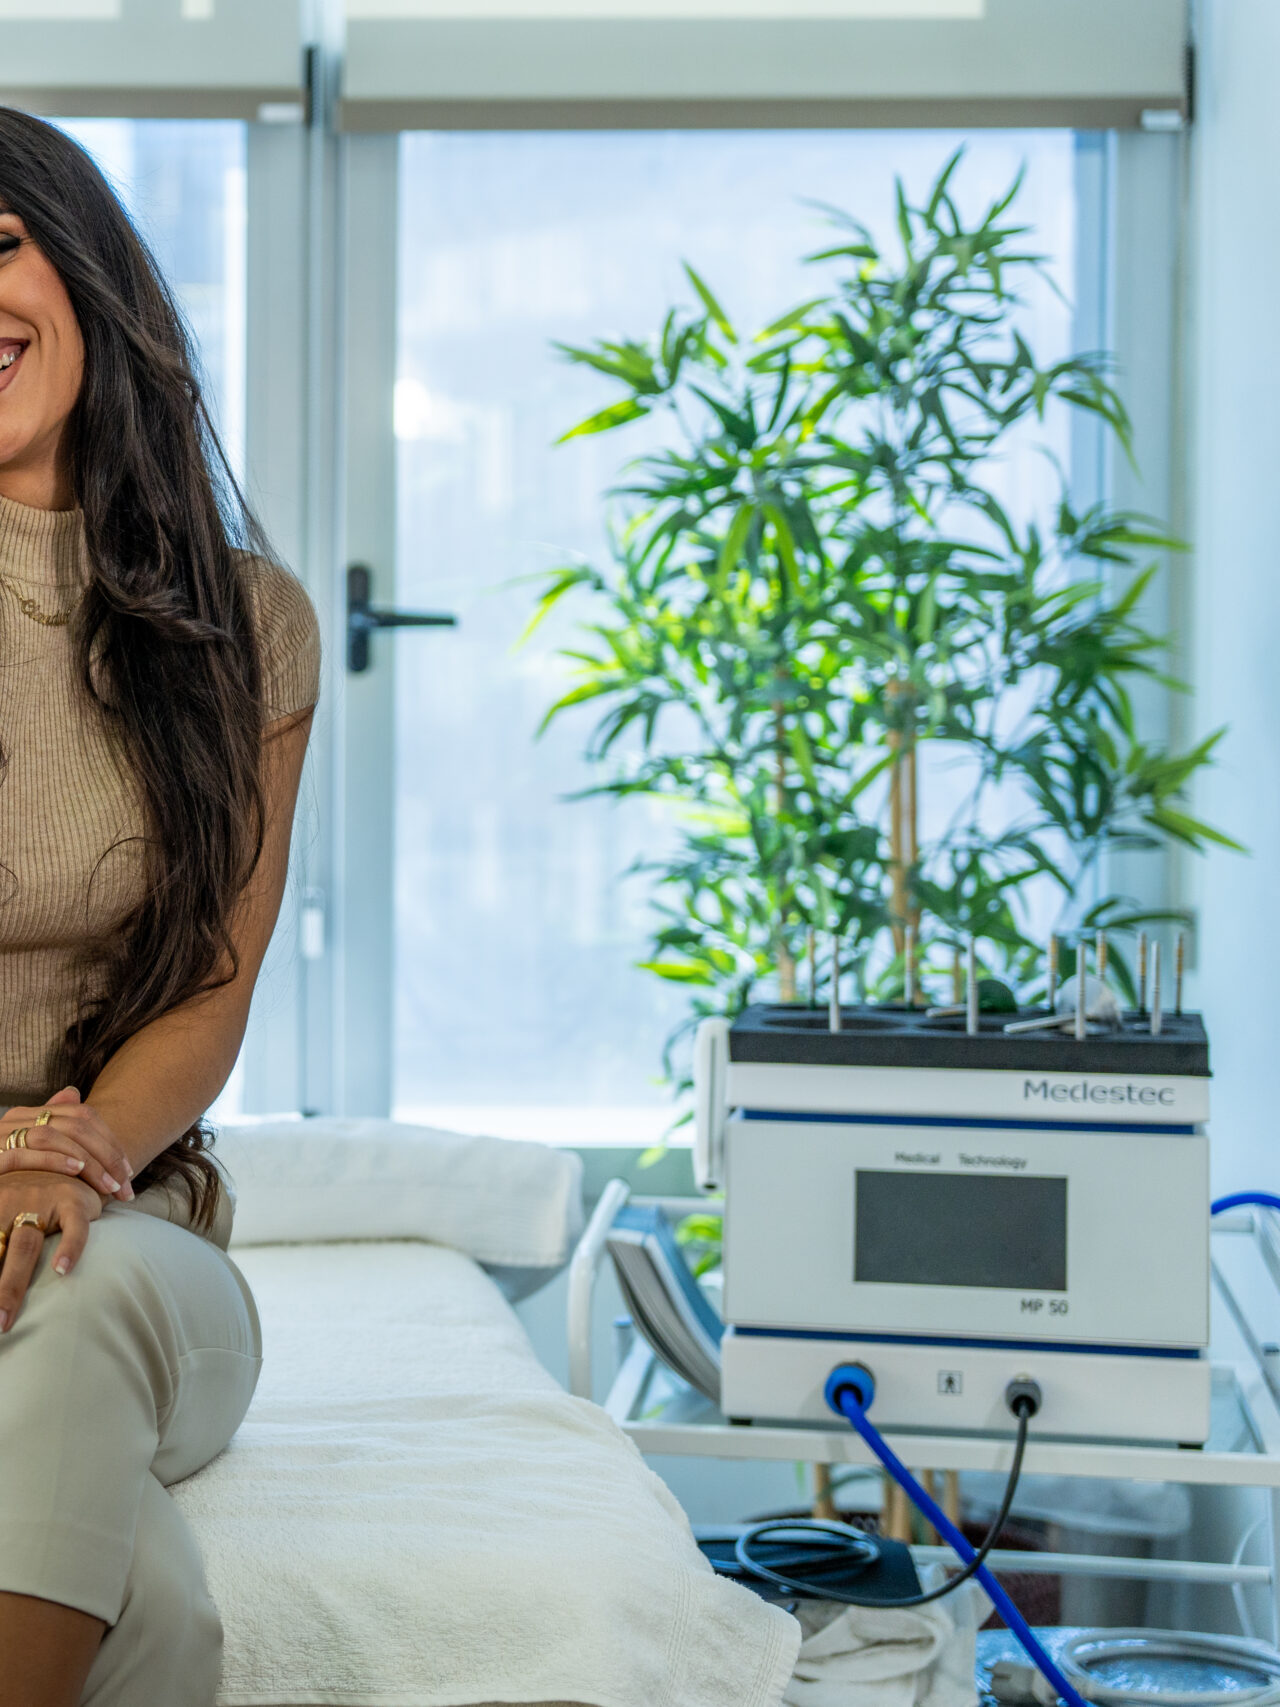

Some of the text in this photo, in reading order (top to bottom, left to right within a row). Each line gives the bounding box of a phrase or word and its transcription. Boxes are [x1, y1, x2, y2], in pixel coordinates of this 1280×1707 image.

[1023, 1079, 1175, 1105] Medestec
[895, 1151, 1027, 1170] Medical Technology
[1021, 1299, 1068, 1316] MP 50
